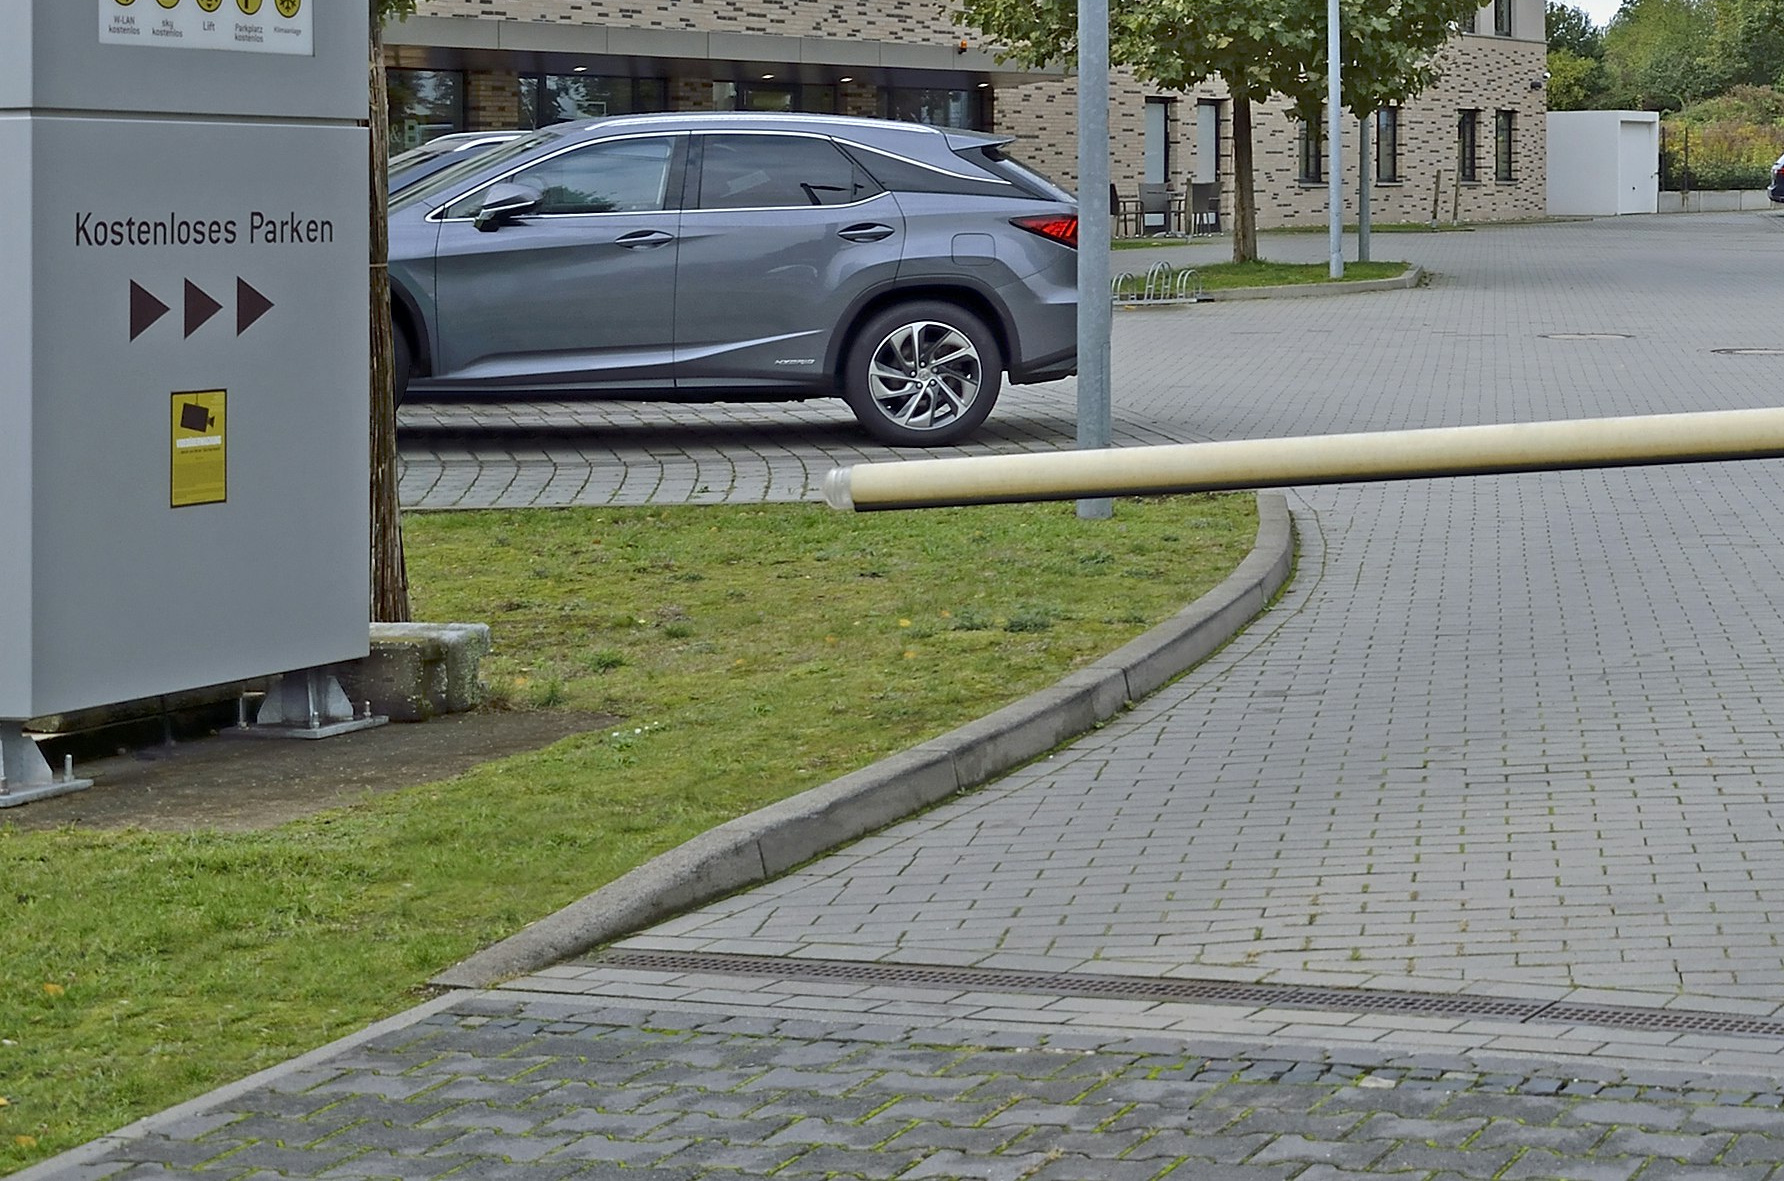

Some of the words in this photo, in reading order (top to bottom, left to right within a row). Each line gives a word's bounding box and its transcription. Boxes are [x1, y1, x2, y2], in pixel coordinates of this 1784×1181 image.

[108, 24, 141, 36] kostenlos
[151, 26, 184, 38] kostenlos
[202, 20, 216, 32] Lift
[235, 22, 264, 34] Parkplatz
[235, 32, 264, 43] kostenlos
[74, 211, 237, 247] Kostenloses
[250, 210, 334, 244] Parken
